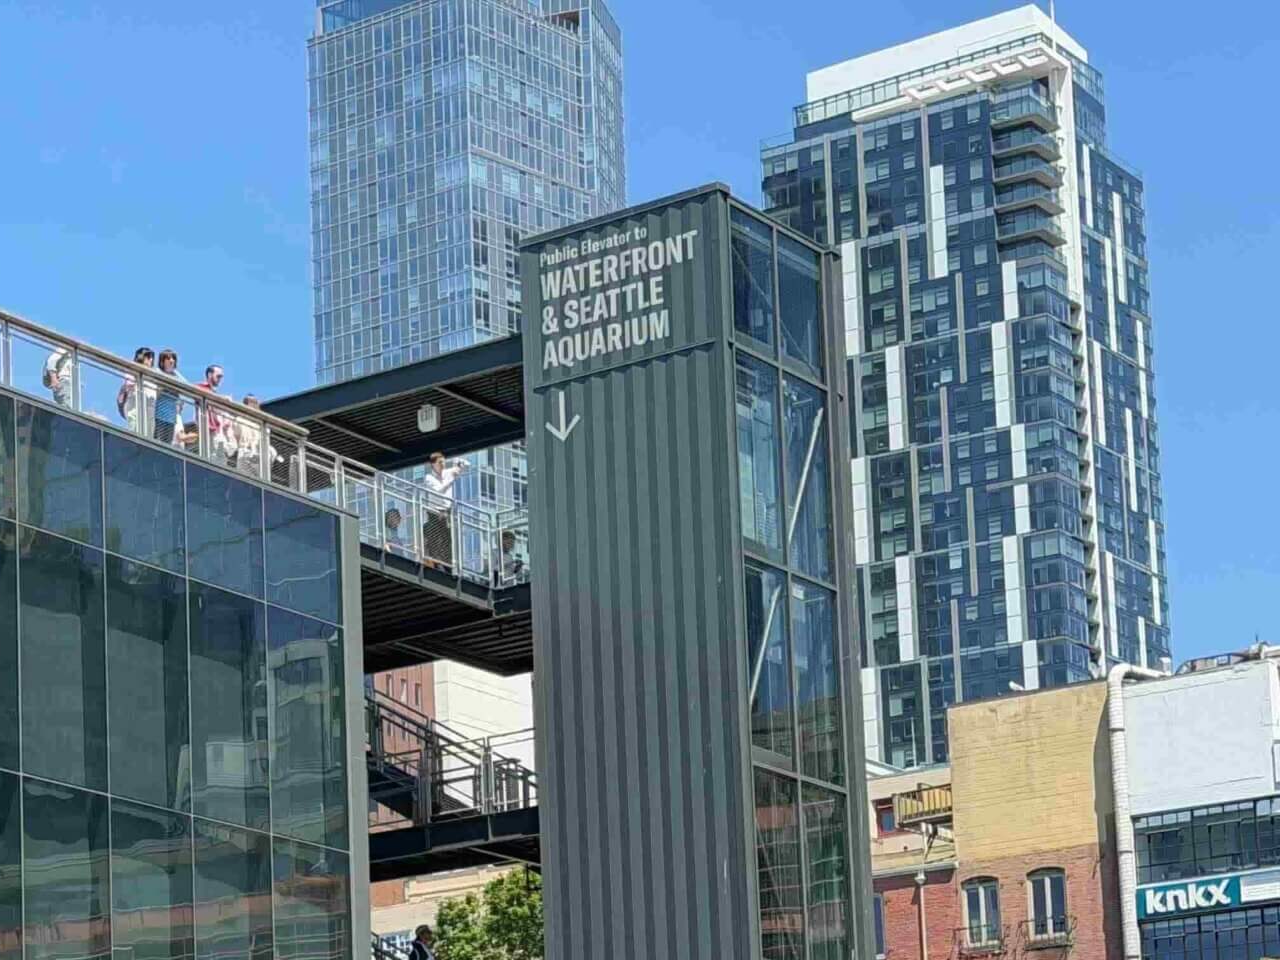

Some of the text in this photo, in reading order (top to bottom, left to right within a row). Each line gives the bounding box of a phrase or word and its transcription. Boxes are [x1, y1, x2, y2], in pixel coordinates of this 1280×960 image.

[540, 227, 647, 267] Public Elevator to
[540, 230, 698, 300] WATERFRONT
[542, 276, 664, 335] & SEATTLE
[543, 309, 669, 370] AQUARIUM
[1145, 879, 1231, 914] knkx
